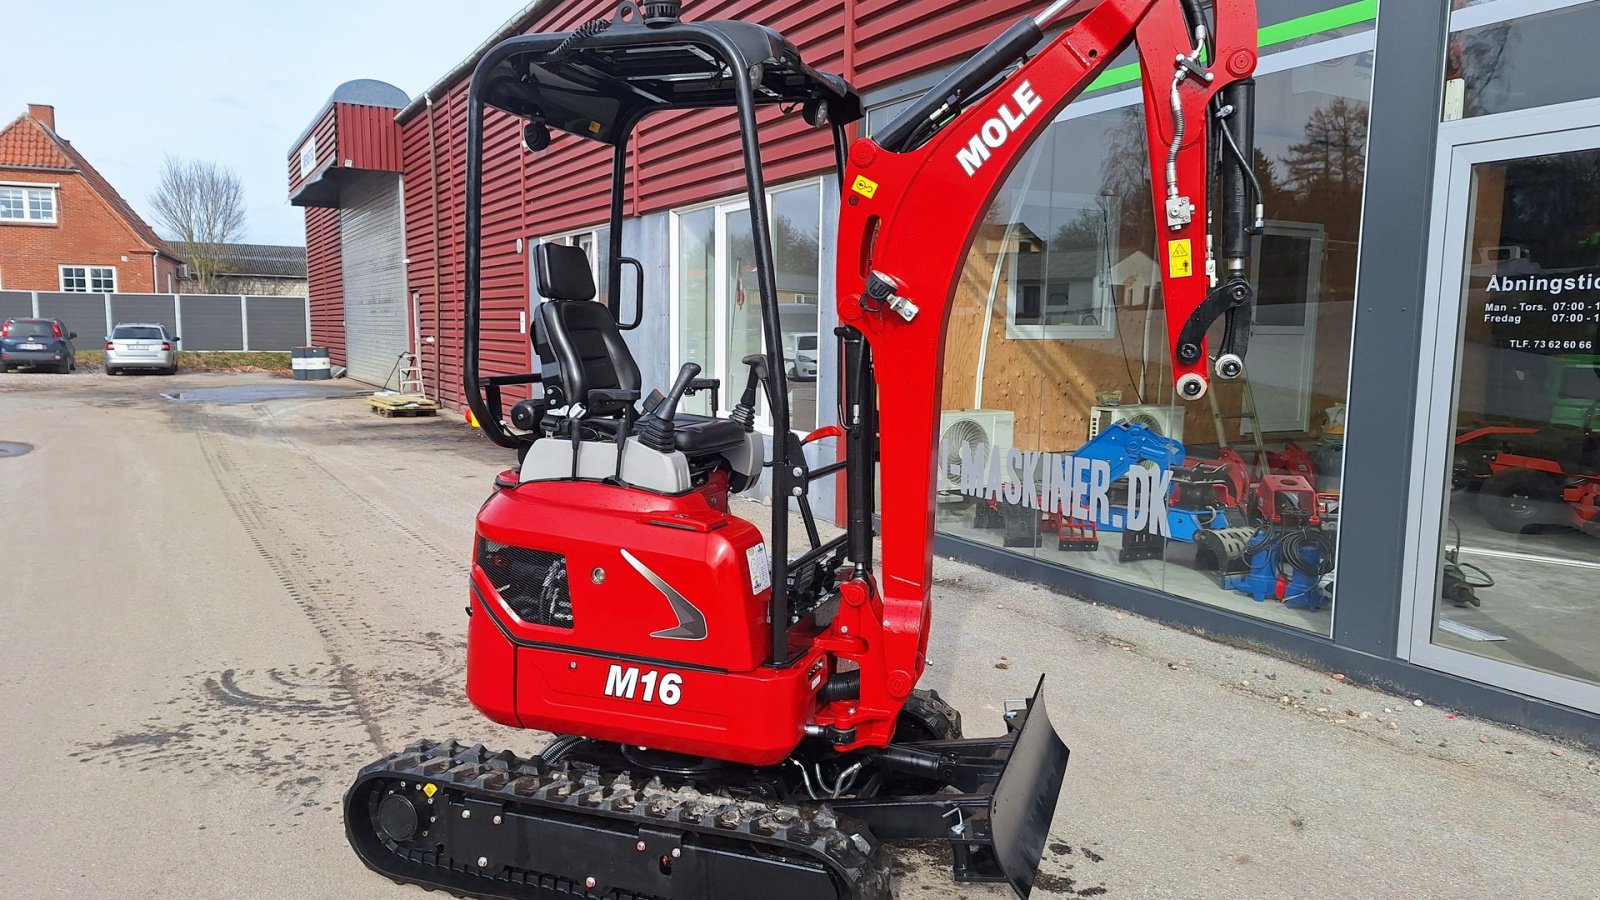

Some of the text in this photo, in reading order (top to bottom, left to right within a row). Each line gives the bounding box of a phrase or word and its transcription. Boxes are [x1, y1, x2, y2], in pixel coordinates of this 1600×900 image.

[955, 79, 1043, 178] MOLE
[1484, 303, 1507, 312] Man
[1552, 302, 1585, 311] 07:00
[1484, 314, 1521, 324] Fredag
[1551, 313, 1584, 322] 07:00
[1509, 340, 1592, 349] TLF. 73 62 60 66
[604, 664, 683, 706] M16
